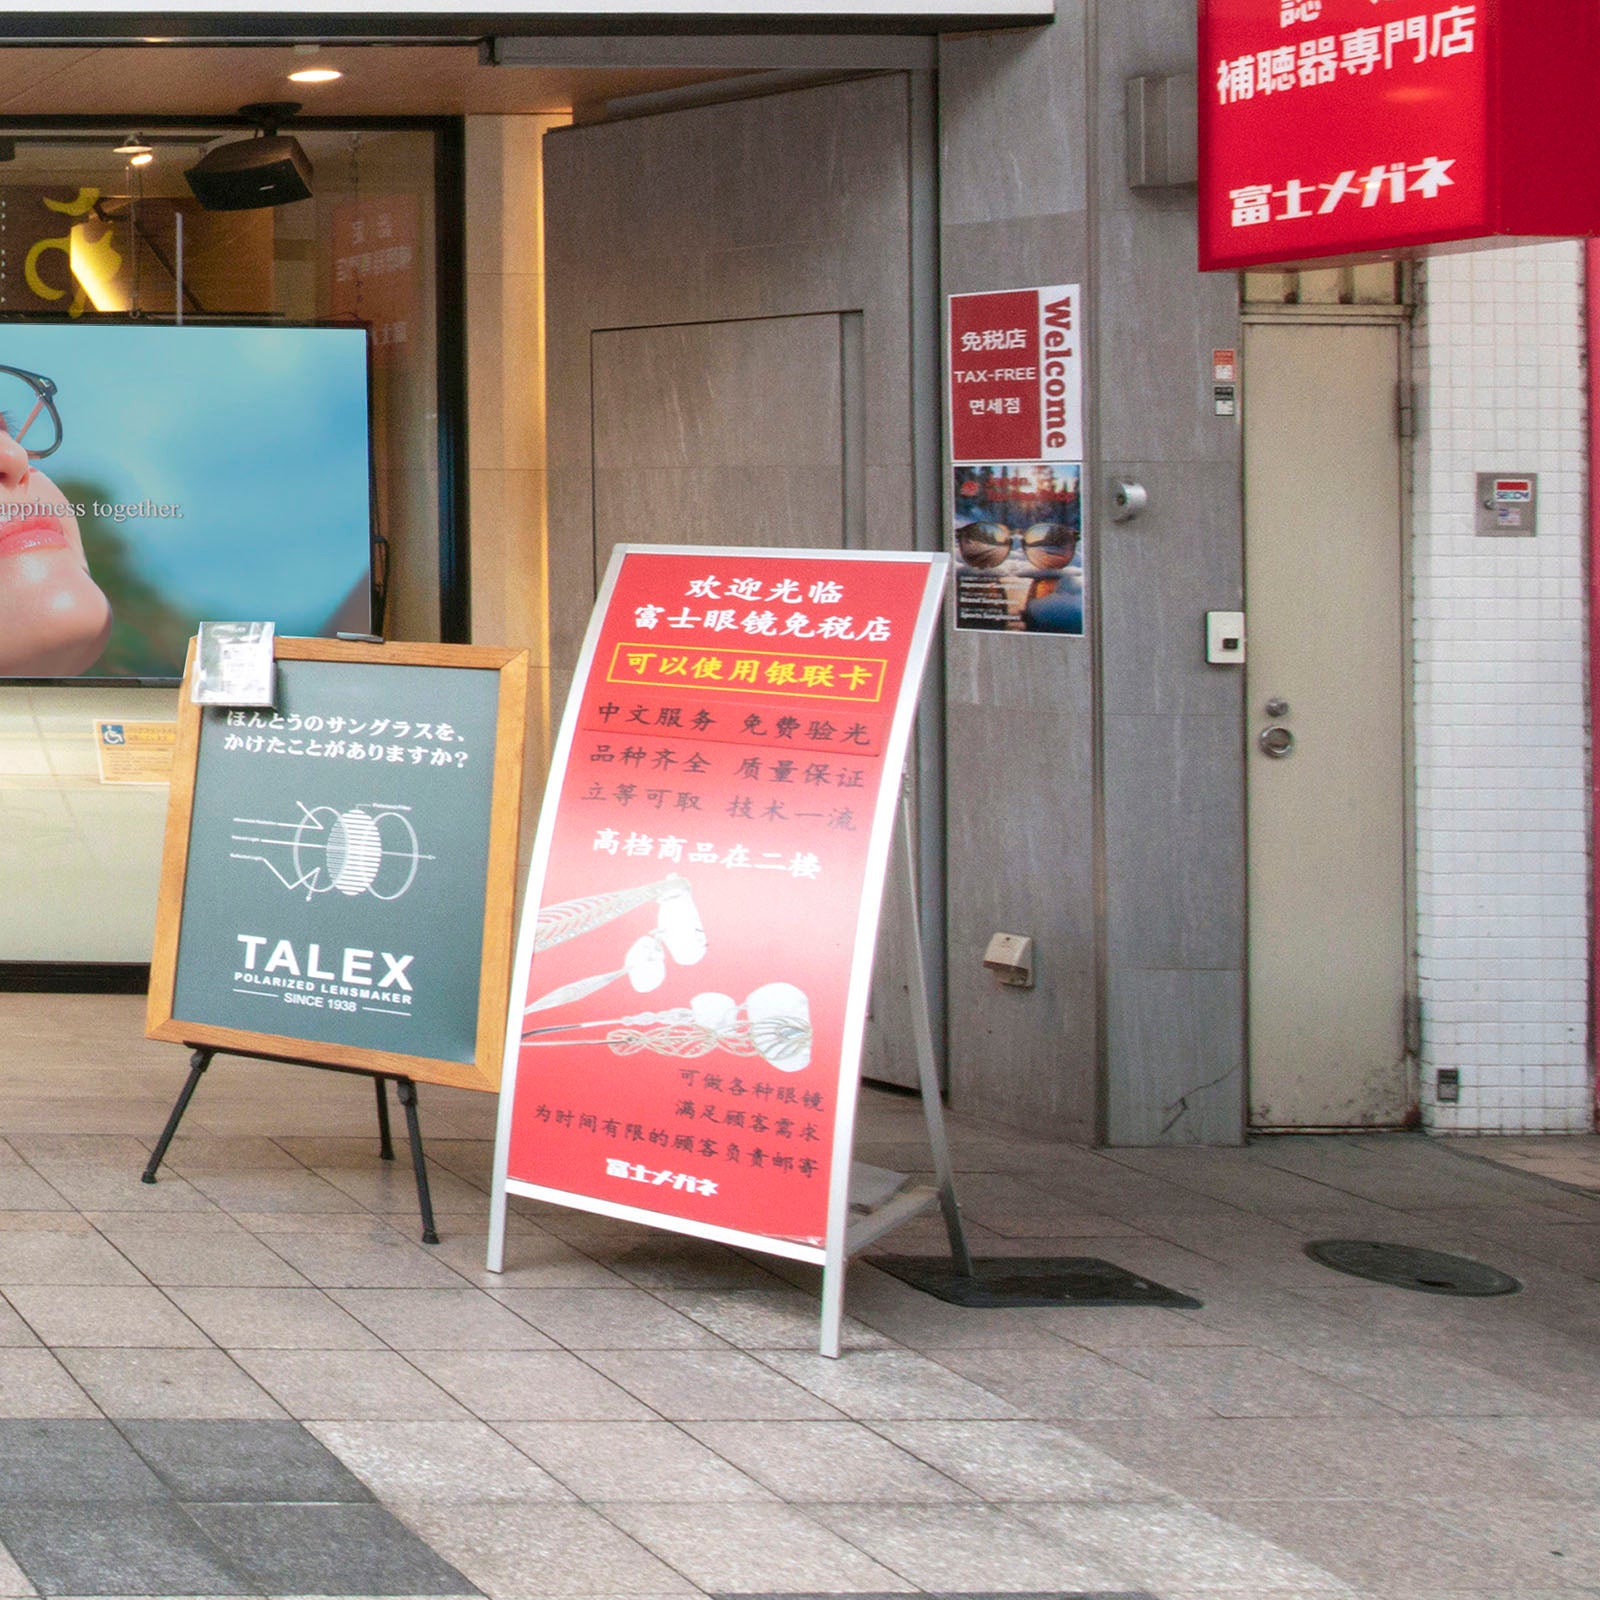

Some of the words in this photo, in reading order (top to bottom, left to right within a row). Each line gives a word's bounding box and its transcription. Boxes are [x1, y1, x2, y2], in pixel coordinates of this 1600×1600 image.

[1216, 5, 1476, 105] 補聴器専門店
[1230, 156, 1456, 228] 富士メガネ
[961, 328, 1028, 352] 免税店
[954, 366, 1037, 384] TAX-FREE
[1044, 296, 1072, 449] Welcome
[969, 397, 1021, 415] 면세점
[93, 499, 185, 523] together.
[684, 575, 844, 604] 欢迎光临
[634, 604, 892, 642] 富士眼镜免税店
[627, 652, 873, 691] 可以使用银联卡
[227, 710, 465, 743] ほんとうのサングラスを、
[598, 701, 718, 732] 中文服务
[738, 713, 872, 746] 免费验光
[590, 744, 712, 775] 品种齐全
[733, 757, 866, 789] 质量保证
[581, 781, 704, 812] 立等可取
[726, 795, 858, 832] 技术一流
[593, 827, 823, 880] 高档商品在二楼
[237, 934, 415, 991] TALEX
[234, 971, 315, 992] POLARIZED
[321, 983, 412, 1004] LENSMAKER
[284, 993, 324, 1008] SINCE
[328, 998, 357, 1013] 1938
[679, 1067, 825, 1113] 可做各种眼镜
[675, 1099, 821, 1143] 满足顾客需求
[606, 1157, 720, 1197] 富士メガネ
